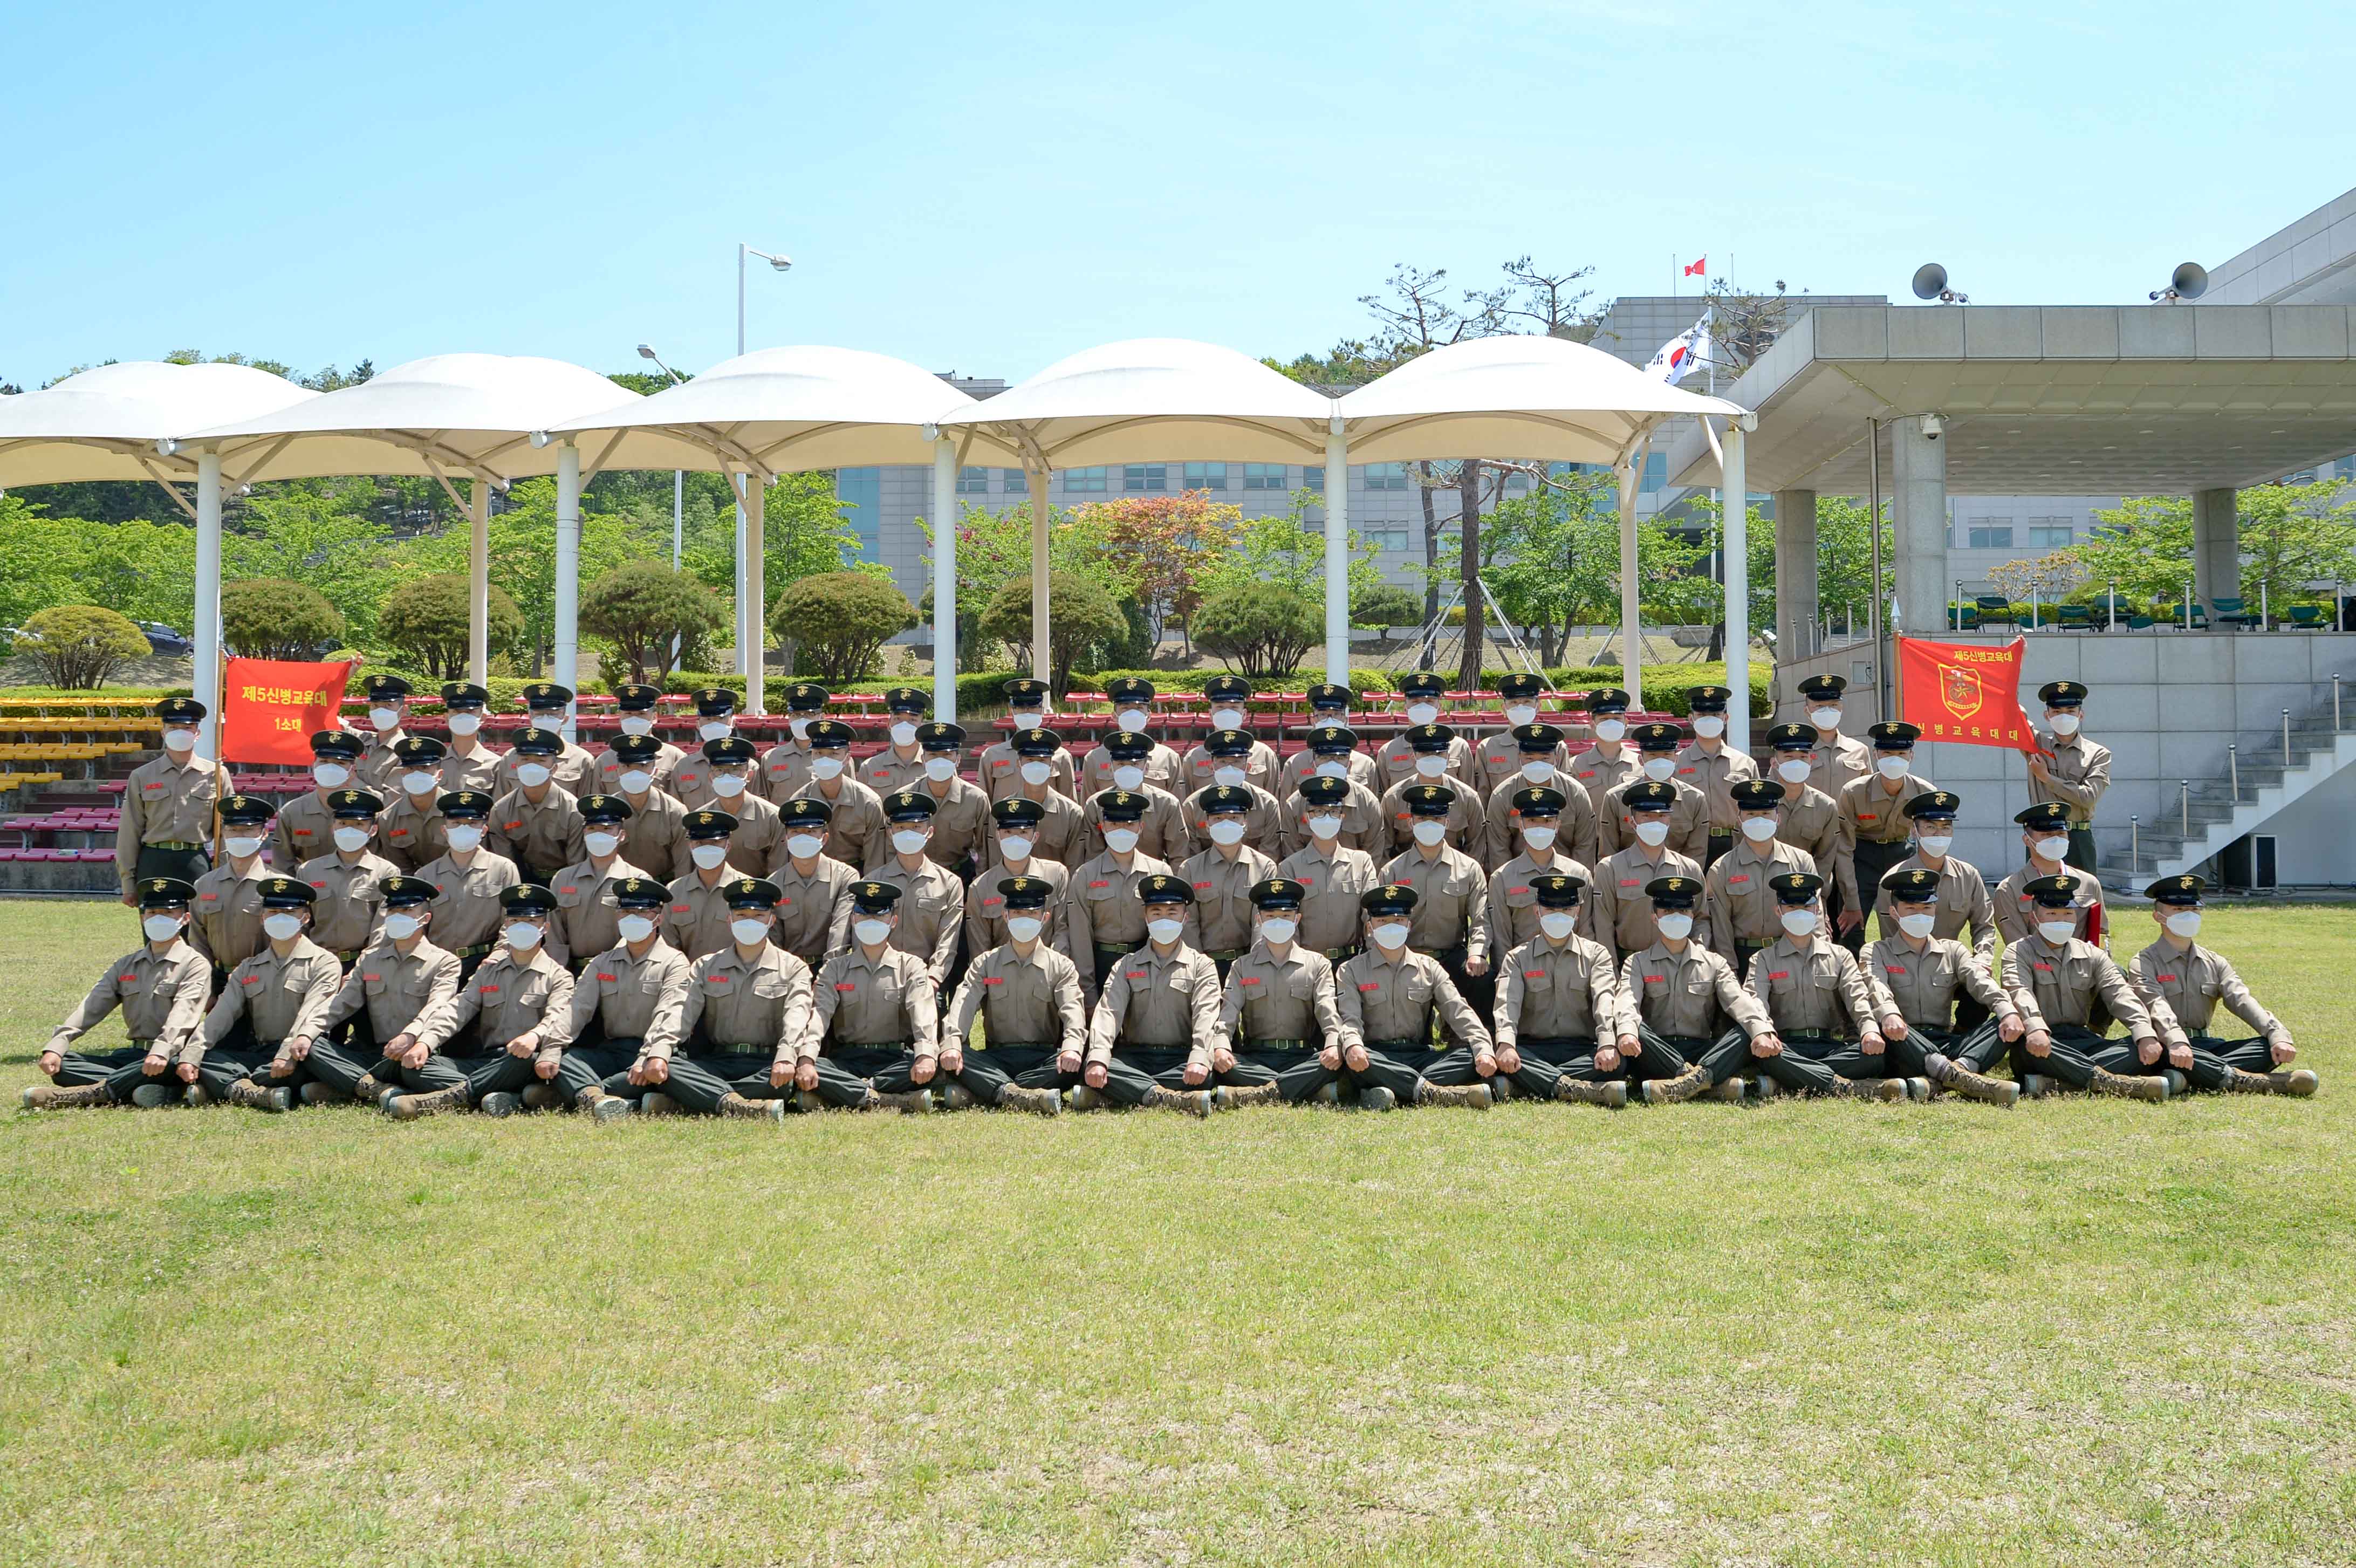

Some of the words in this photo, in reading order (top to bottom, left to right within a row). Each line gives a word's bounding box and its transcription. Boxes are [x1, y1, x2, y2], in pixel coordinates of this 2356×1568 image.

[1954, 651, 2013, 663] 제5신병교육대
[242, 686, 327, 707] 제5신병교육대
[275, 718, 302, 732] 1소대
